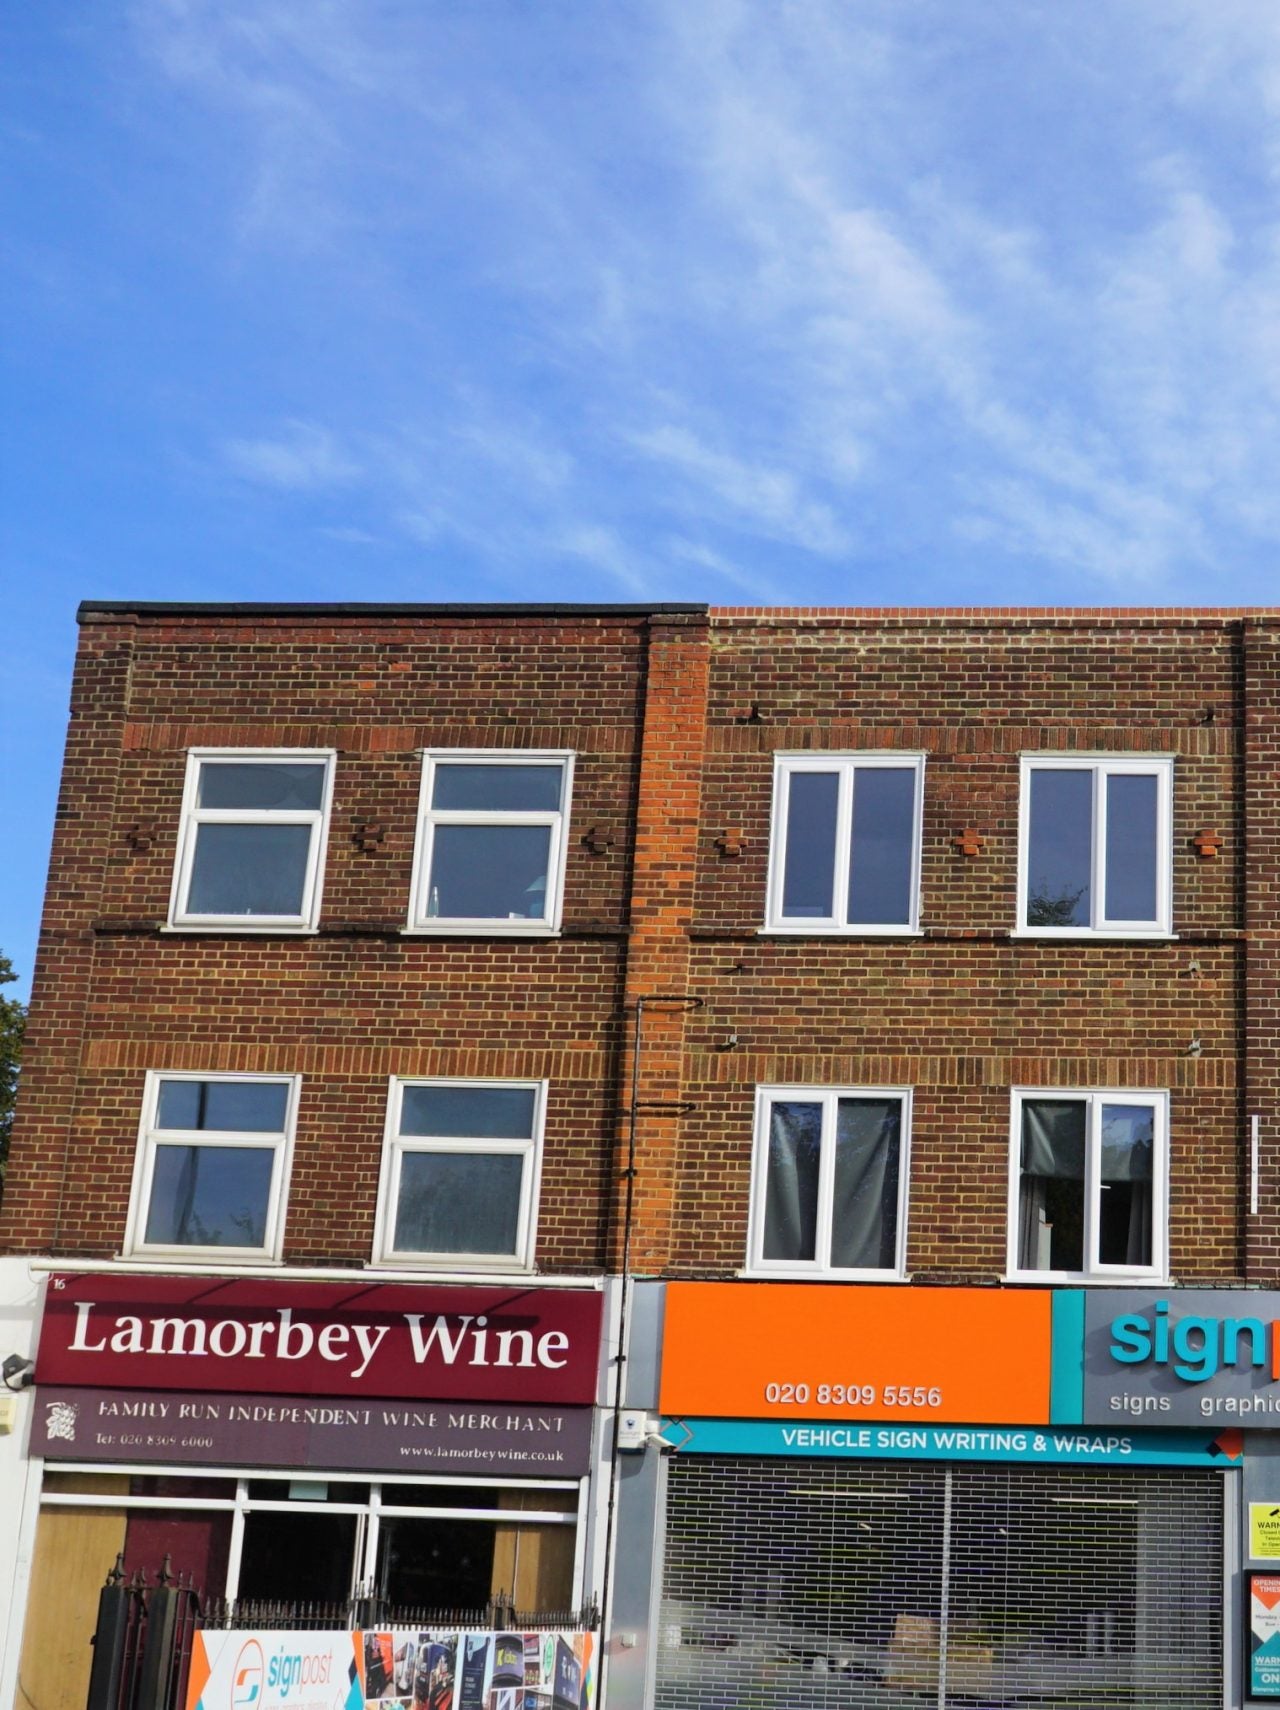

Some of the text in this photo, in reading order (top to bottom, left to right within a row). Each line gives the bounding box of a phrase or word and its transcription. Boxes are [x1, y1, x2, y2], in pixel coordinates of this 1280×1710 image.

[53, 1279, 66, 1290] 16
[67, 1301, 570, 1378] Lamorbey Wine
[765, 1382, 942, 1407] 020 8309 5556
[1110, 1392, 1171, 1415] signs
[98, 1401, 564, 1433] FAMILY RUN INDEPENDENT WINE MERCHANT
[120, 1433, 143, 1446] 020
[782, 1428, 1133, 1455] VEHICLE SIGN WRITING & WRAPS
[400, 1446, 565, 1462] www.lamorbeywine.co.uk
[267, 1645, 333, 1698] signpost
